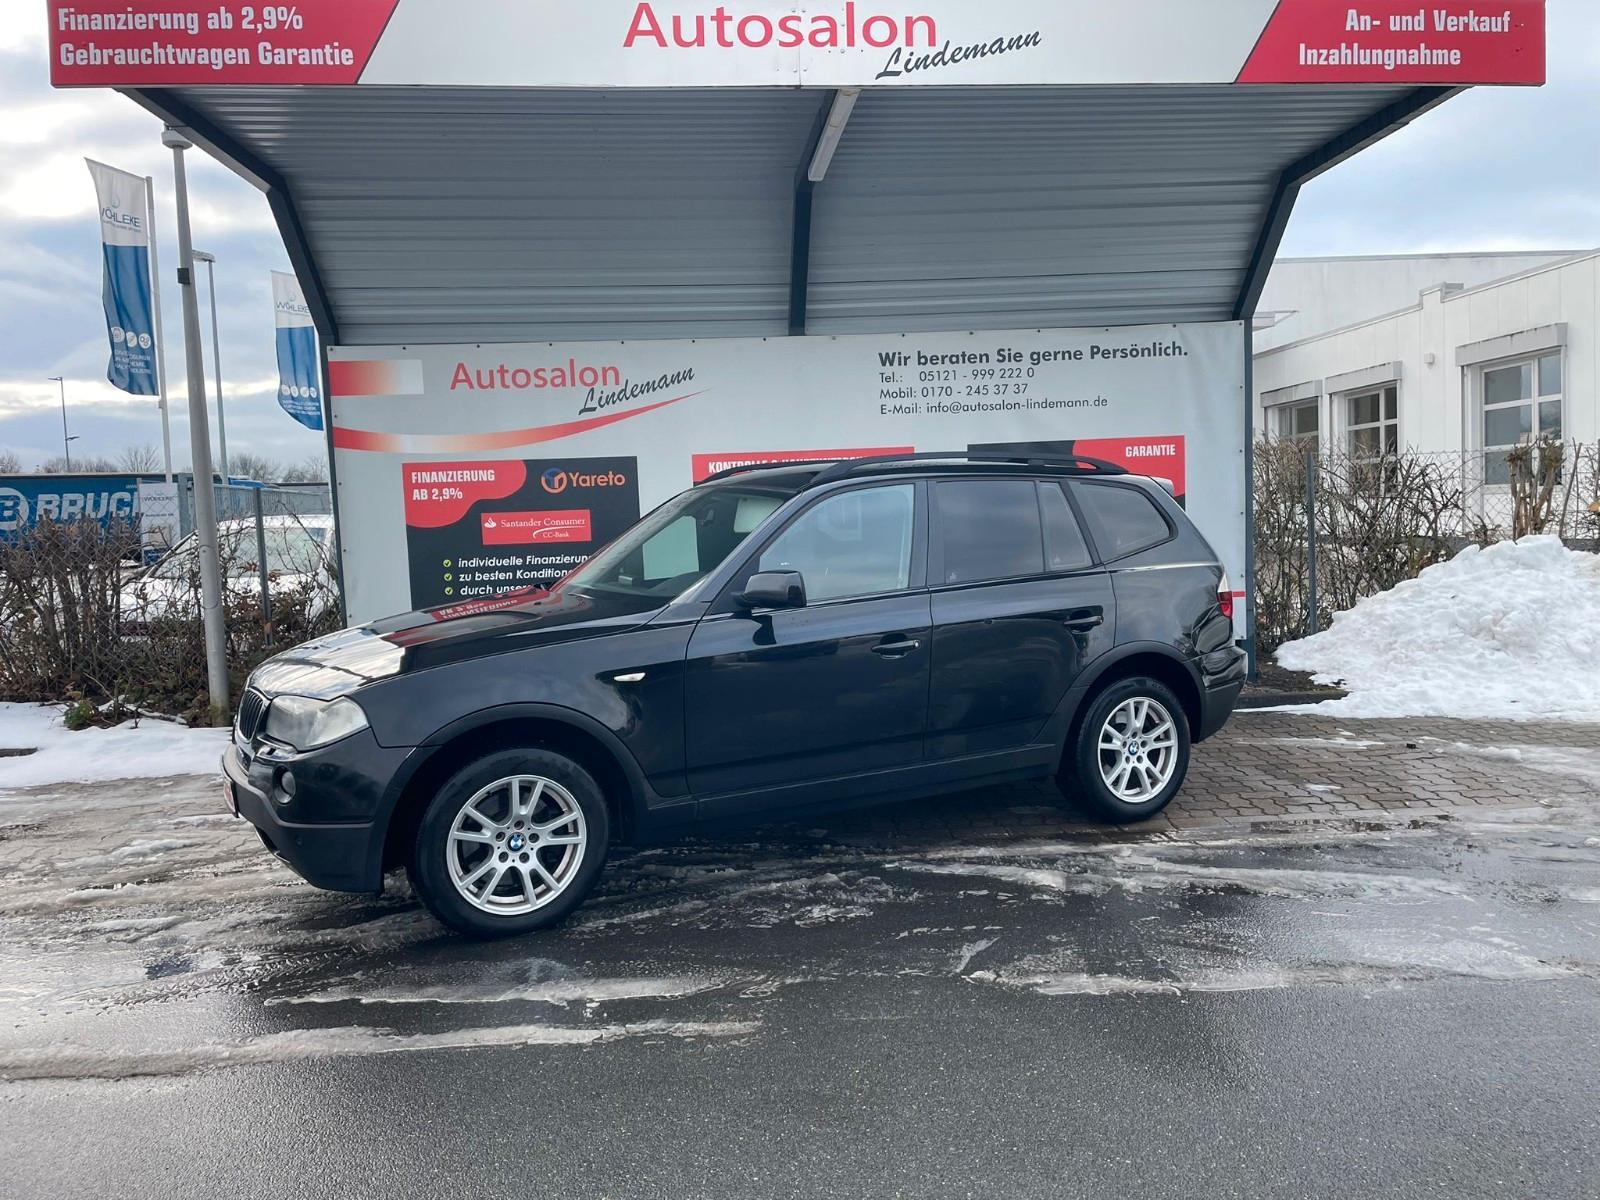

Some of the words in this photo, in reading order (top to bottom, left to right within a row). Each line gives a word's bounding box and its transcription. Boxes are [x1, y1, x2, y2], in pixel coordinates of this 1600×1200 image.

[58, 7, 199, 35] Finanzierung
[207, 6, 233, 30] ab
[241, 6, 303, 34] 2,9%
[622, 1, 937, 48] Autosalon
[1345, 9, 1381, 31] An-
[1389, 9, 1425, 32] und
[1433, 9, 1511, 33] Verkauf
[60, 41, 250, 70] Gebrauchtwagen
[257, 41, 354, 66] Garantie
[875, 30, 1042, 80] Lindemann
[1299, 43, 1461, 70] Inzahlungnahme
[878, 351, 911, 367] Wir
[917, 349, 990, 366] beraten
[996, 347, 1024, 364] Sie
[1029, 349, 1084, 366] gerne
[1089, 341, 1188, 360] Persönlich.
[450, 358, 620, 391] Autosalon
[879, 371, 904, 384] Tel.:
[919, 370, 958, 383] 05121
[971, 368, 995, 381] 999
[999, 368, 1023, 380] 222
[1026, 367, 1035, 379] 0
[578, 367, 695, 416] Lindemann
[879, 386, 917, 400] Mobil:
[921, 385, 953, 398] 0170
[966, 385, 990, 397] 245
[993, 384, 1009, 396] 37
[1012, 383, 1028, 395] 37
[880, 402, 922, 416] E-Mail:
[926, 395, 1108, 415] info@autosalon-lindemann.de
[1125, 444, 1176, 458] GARANTIE
[411, 469, 496, 484] FINANZIERUNG
[568, 470, 626, 488] Yareto
[412, 488, 428, 501] AB
[431, 487, 463, 502] 2,9%
[500, 518, 541, 528] Santander
[543, 517, 585, 526] Consumer
[458, 556, 523, 568] individuelle
[526, 554, 592, 566] Finanzierun
[458, 572, 472, 582] zu
[475, 570, 513, 581] besten
[460, 584, 493, 596] durch
